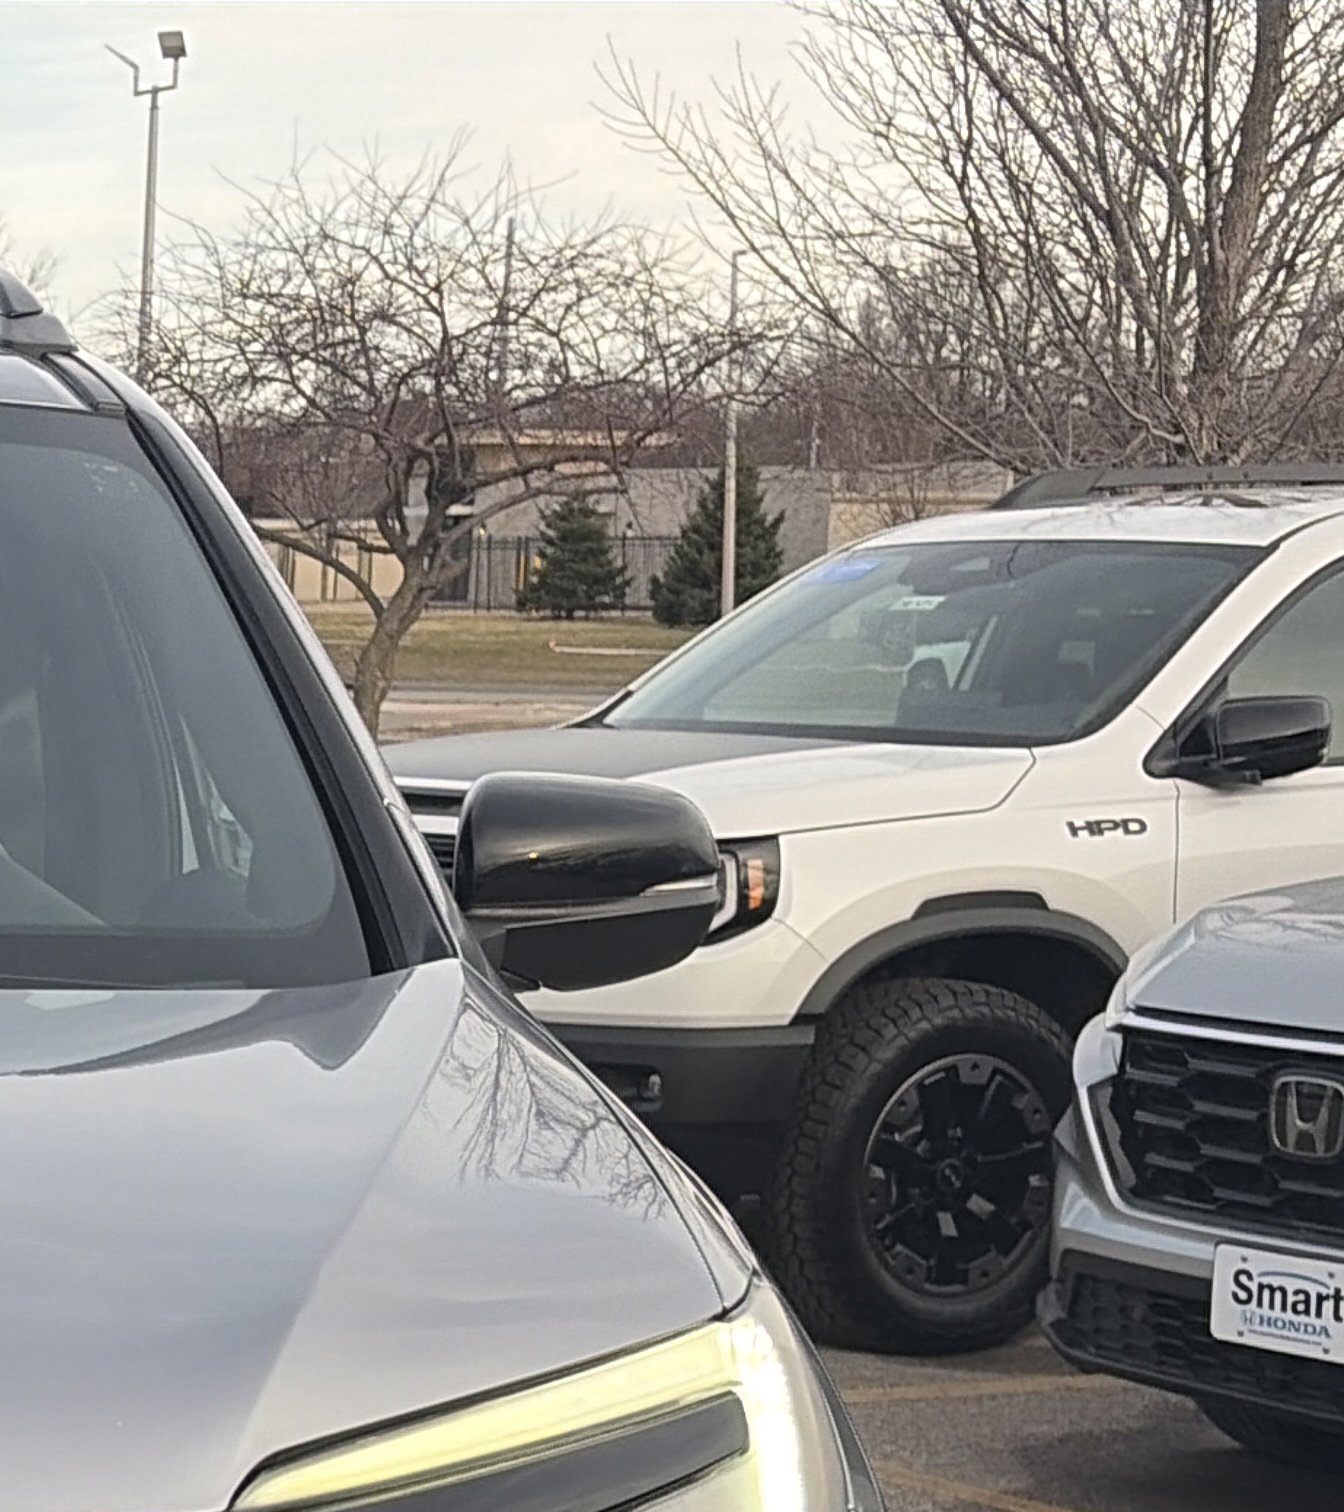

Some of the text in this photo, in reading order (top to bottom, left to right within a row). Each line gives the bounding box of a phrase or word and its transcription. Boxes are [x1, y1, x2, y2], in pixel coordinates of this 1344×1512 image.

[1066, 817, 1148, 838] HPD
[1231, 1268, 1344, 1323] Smart
[1258, 1314, 1332, 1339] HONDA
